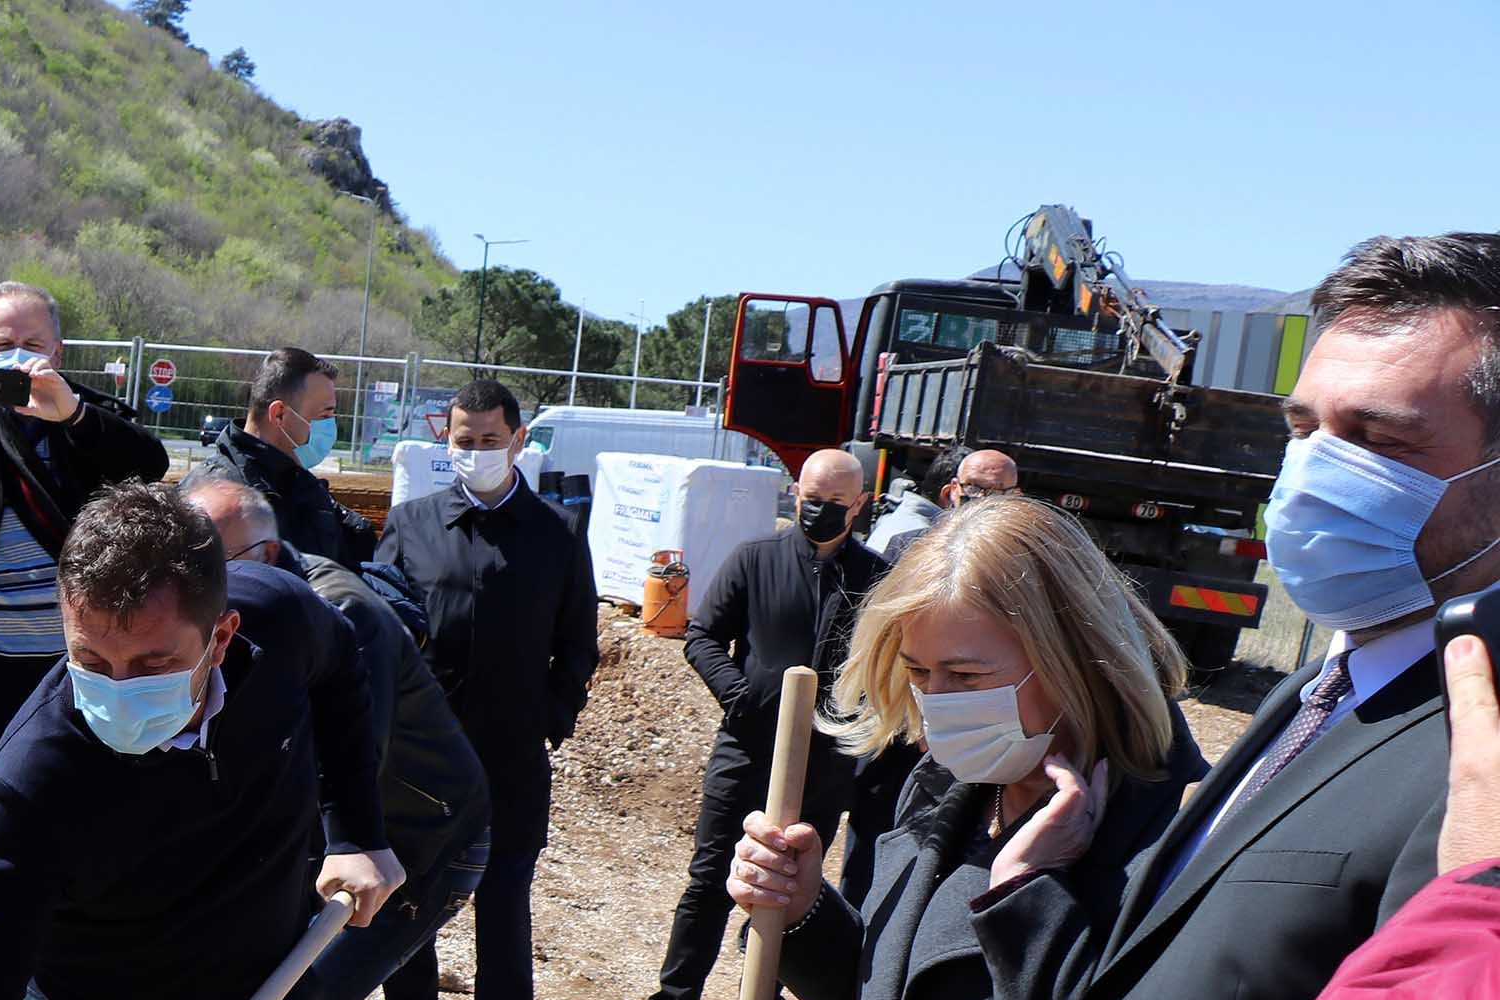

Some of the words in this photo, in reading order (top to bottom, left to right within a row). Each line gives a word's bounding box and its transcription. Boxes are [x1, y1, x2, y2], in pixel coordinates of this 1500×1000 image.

[152, 367, 174, 378] STOP
[1066, 495, 1081, 509] 80
[615, 504, 655, 520] FRAGMAT
[1141, 504, 1156, 517] 70
